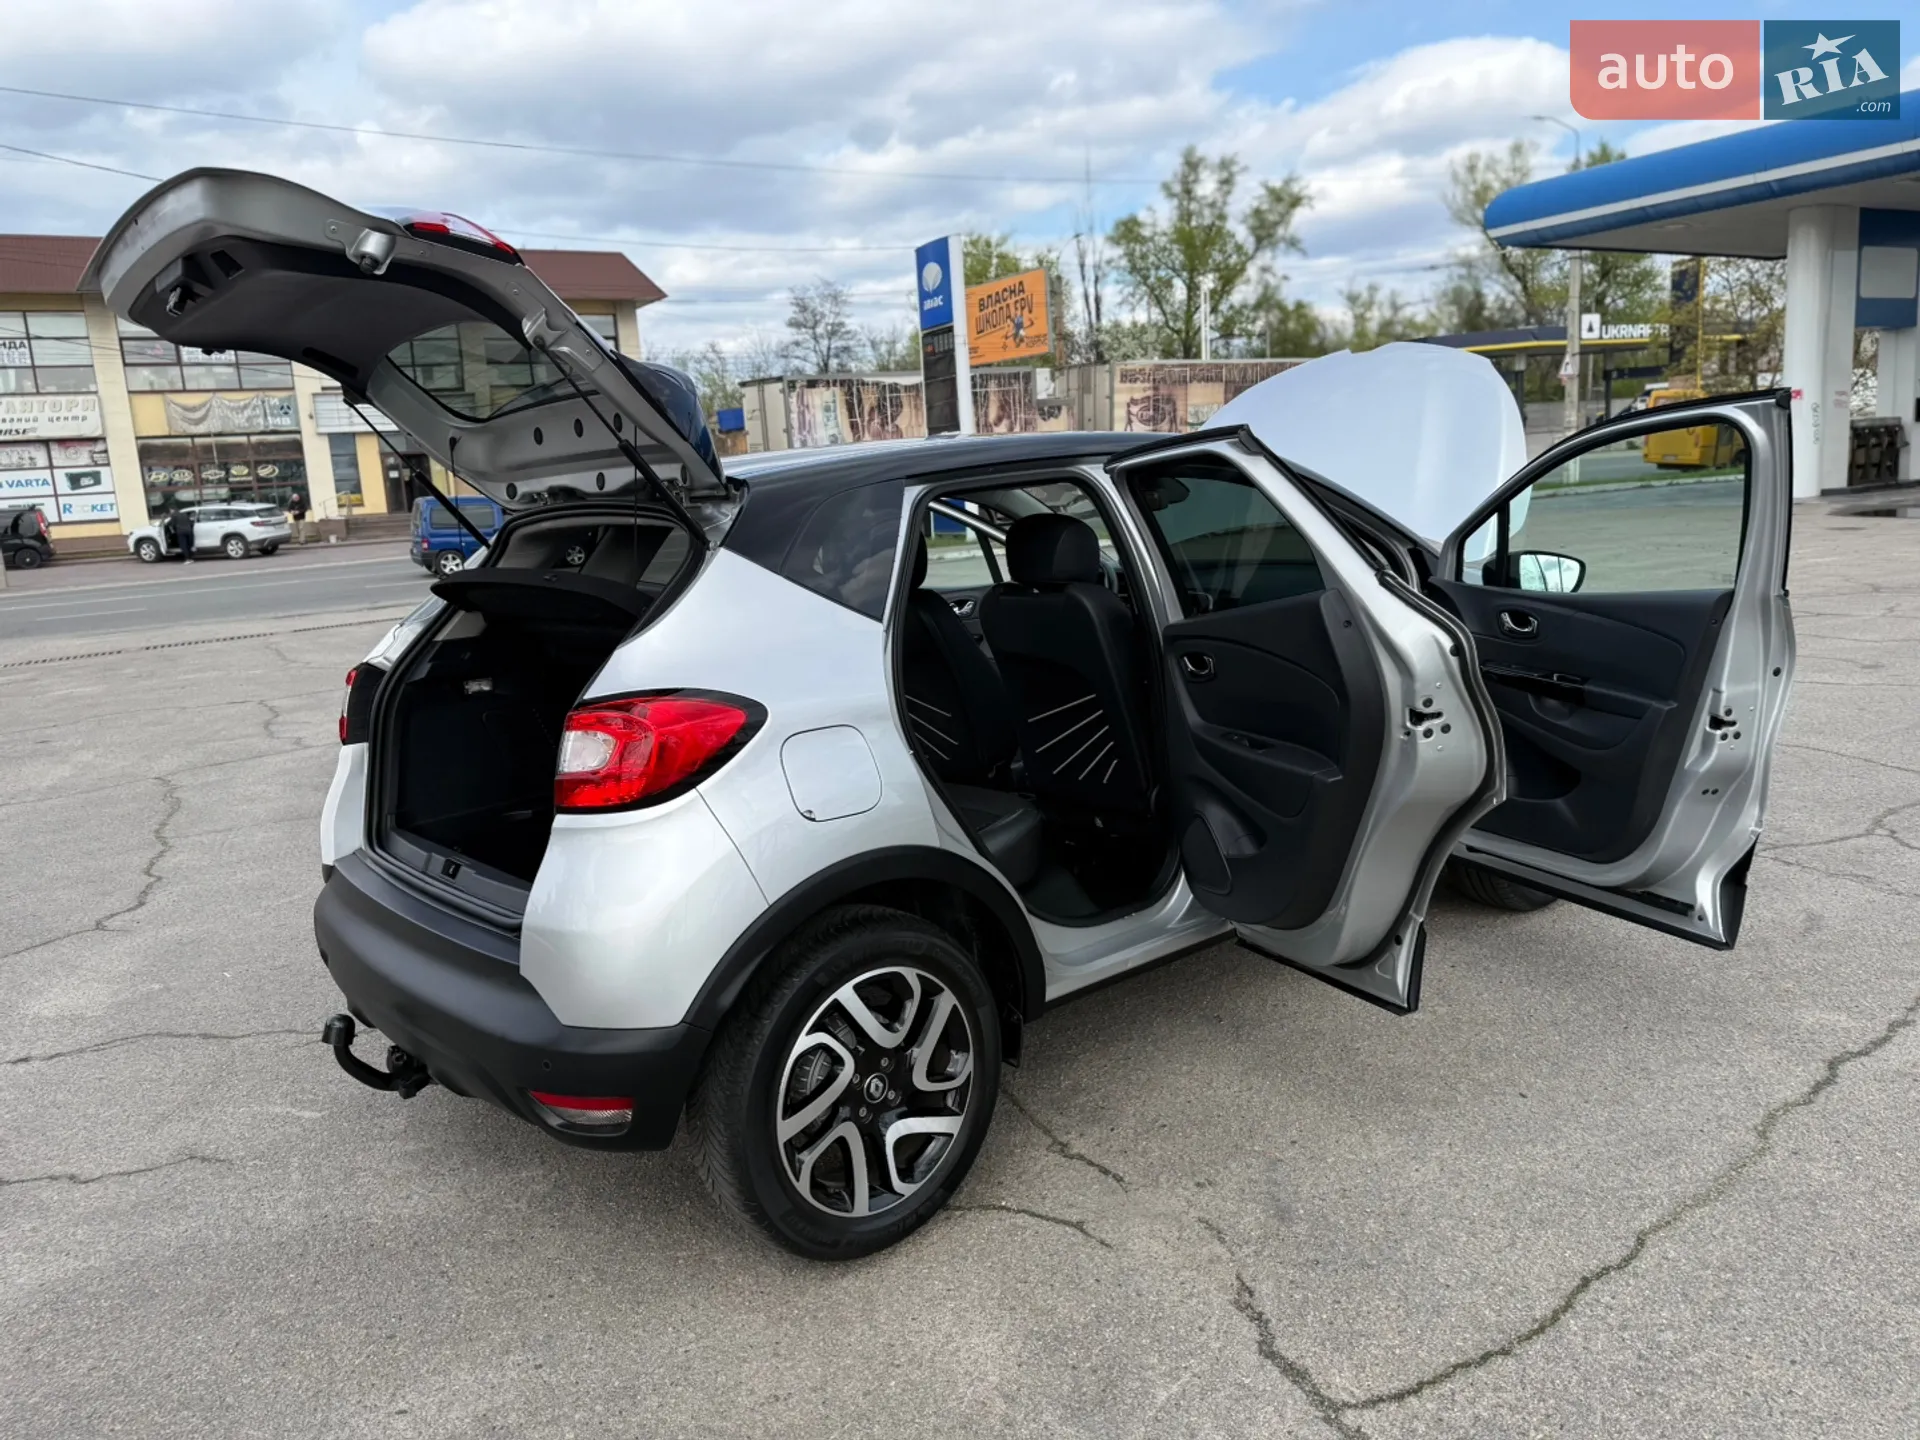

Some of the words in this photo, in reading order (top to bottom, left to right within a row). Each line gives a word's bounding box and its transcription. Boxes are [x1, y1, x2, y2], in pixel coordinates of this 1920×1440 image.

[978, 280, 1025, 313] ВЛАСНА
[975, 303, 1012, 335] ШКОЛА
[0, 399, 97, 414] ЛЯТОРИ
[5, 478, 51, 489] VARTA
